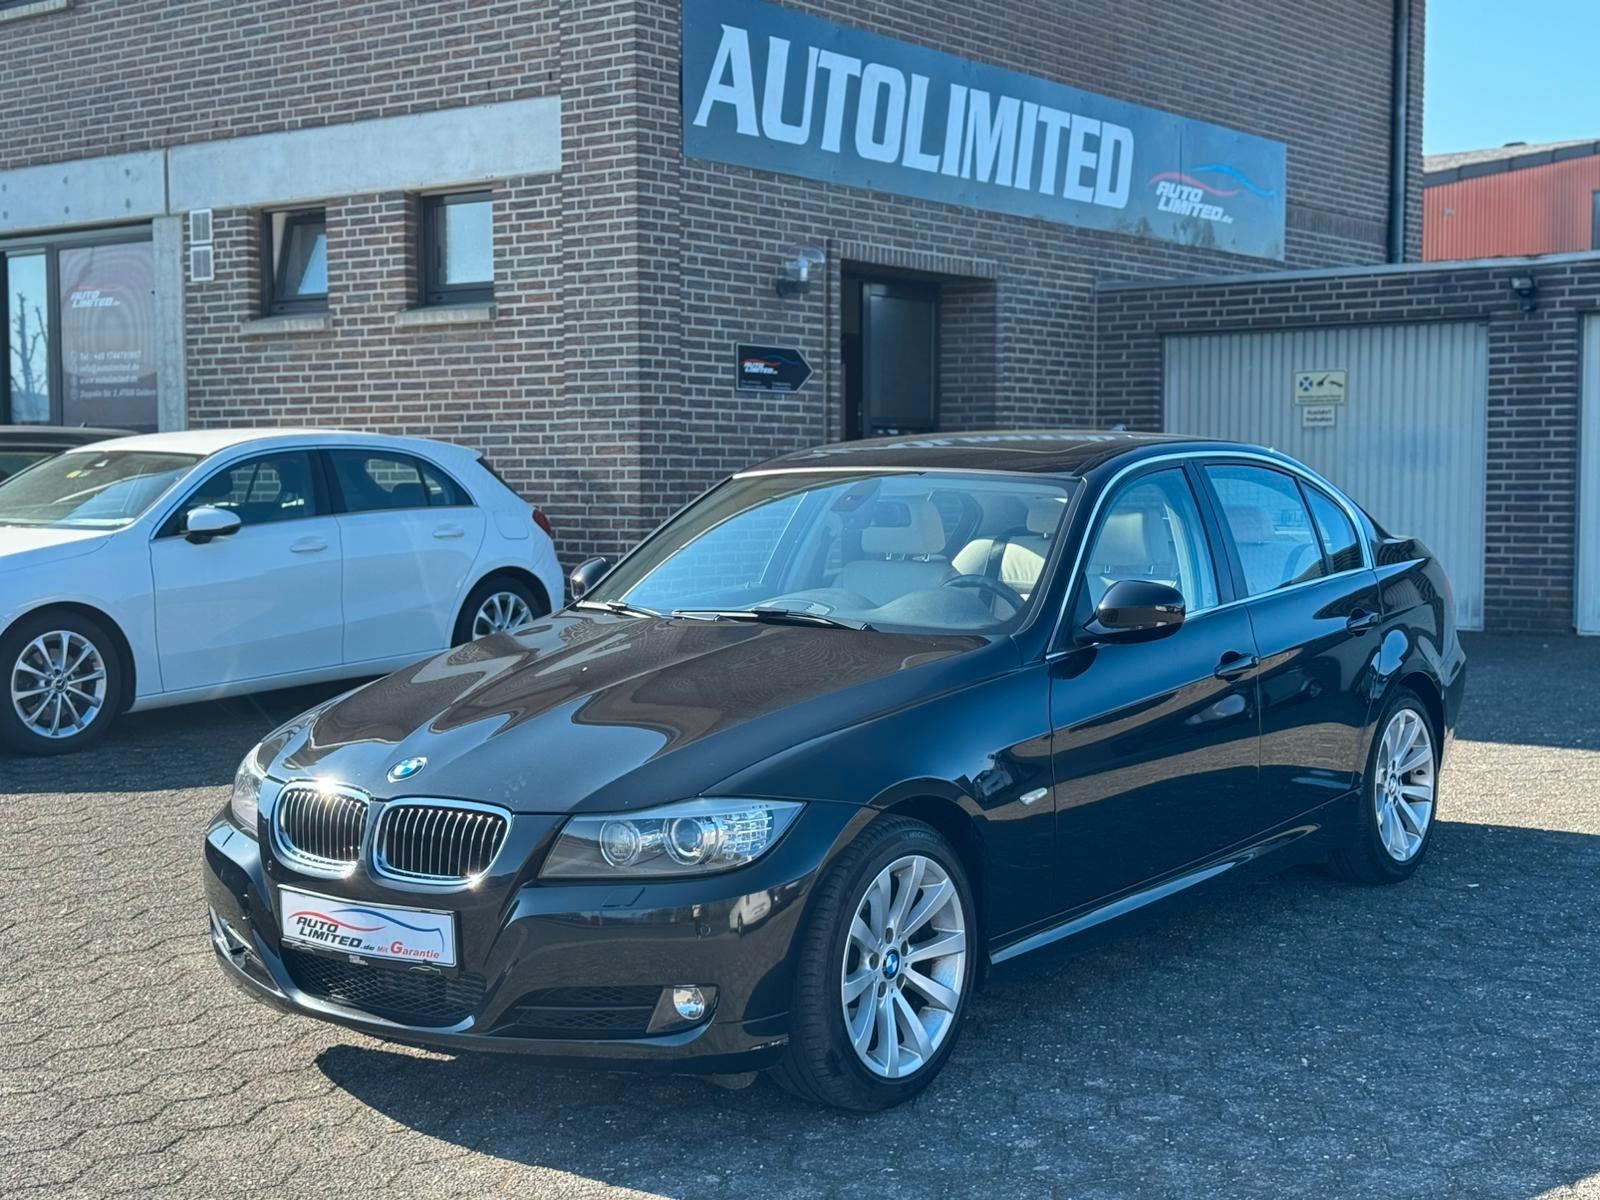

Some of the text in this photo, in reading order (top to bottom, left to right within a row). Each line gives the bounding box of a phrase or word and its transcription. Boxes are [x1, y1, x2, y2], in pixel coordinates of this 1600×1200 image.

[693, 23, 1134, 209] AUTOLIMITED
[1155, 181, 1204, 203] AUTO
[1157, 196, 1234, 224] LIMITED.de
[296, 916, 339, 933] AUTO
[299, 926, 375, 951] LIMITED.de
[390, 941, 440, 959] Garantie
